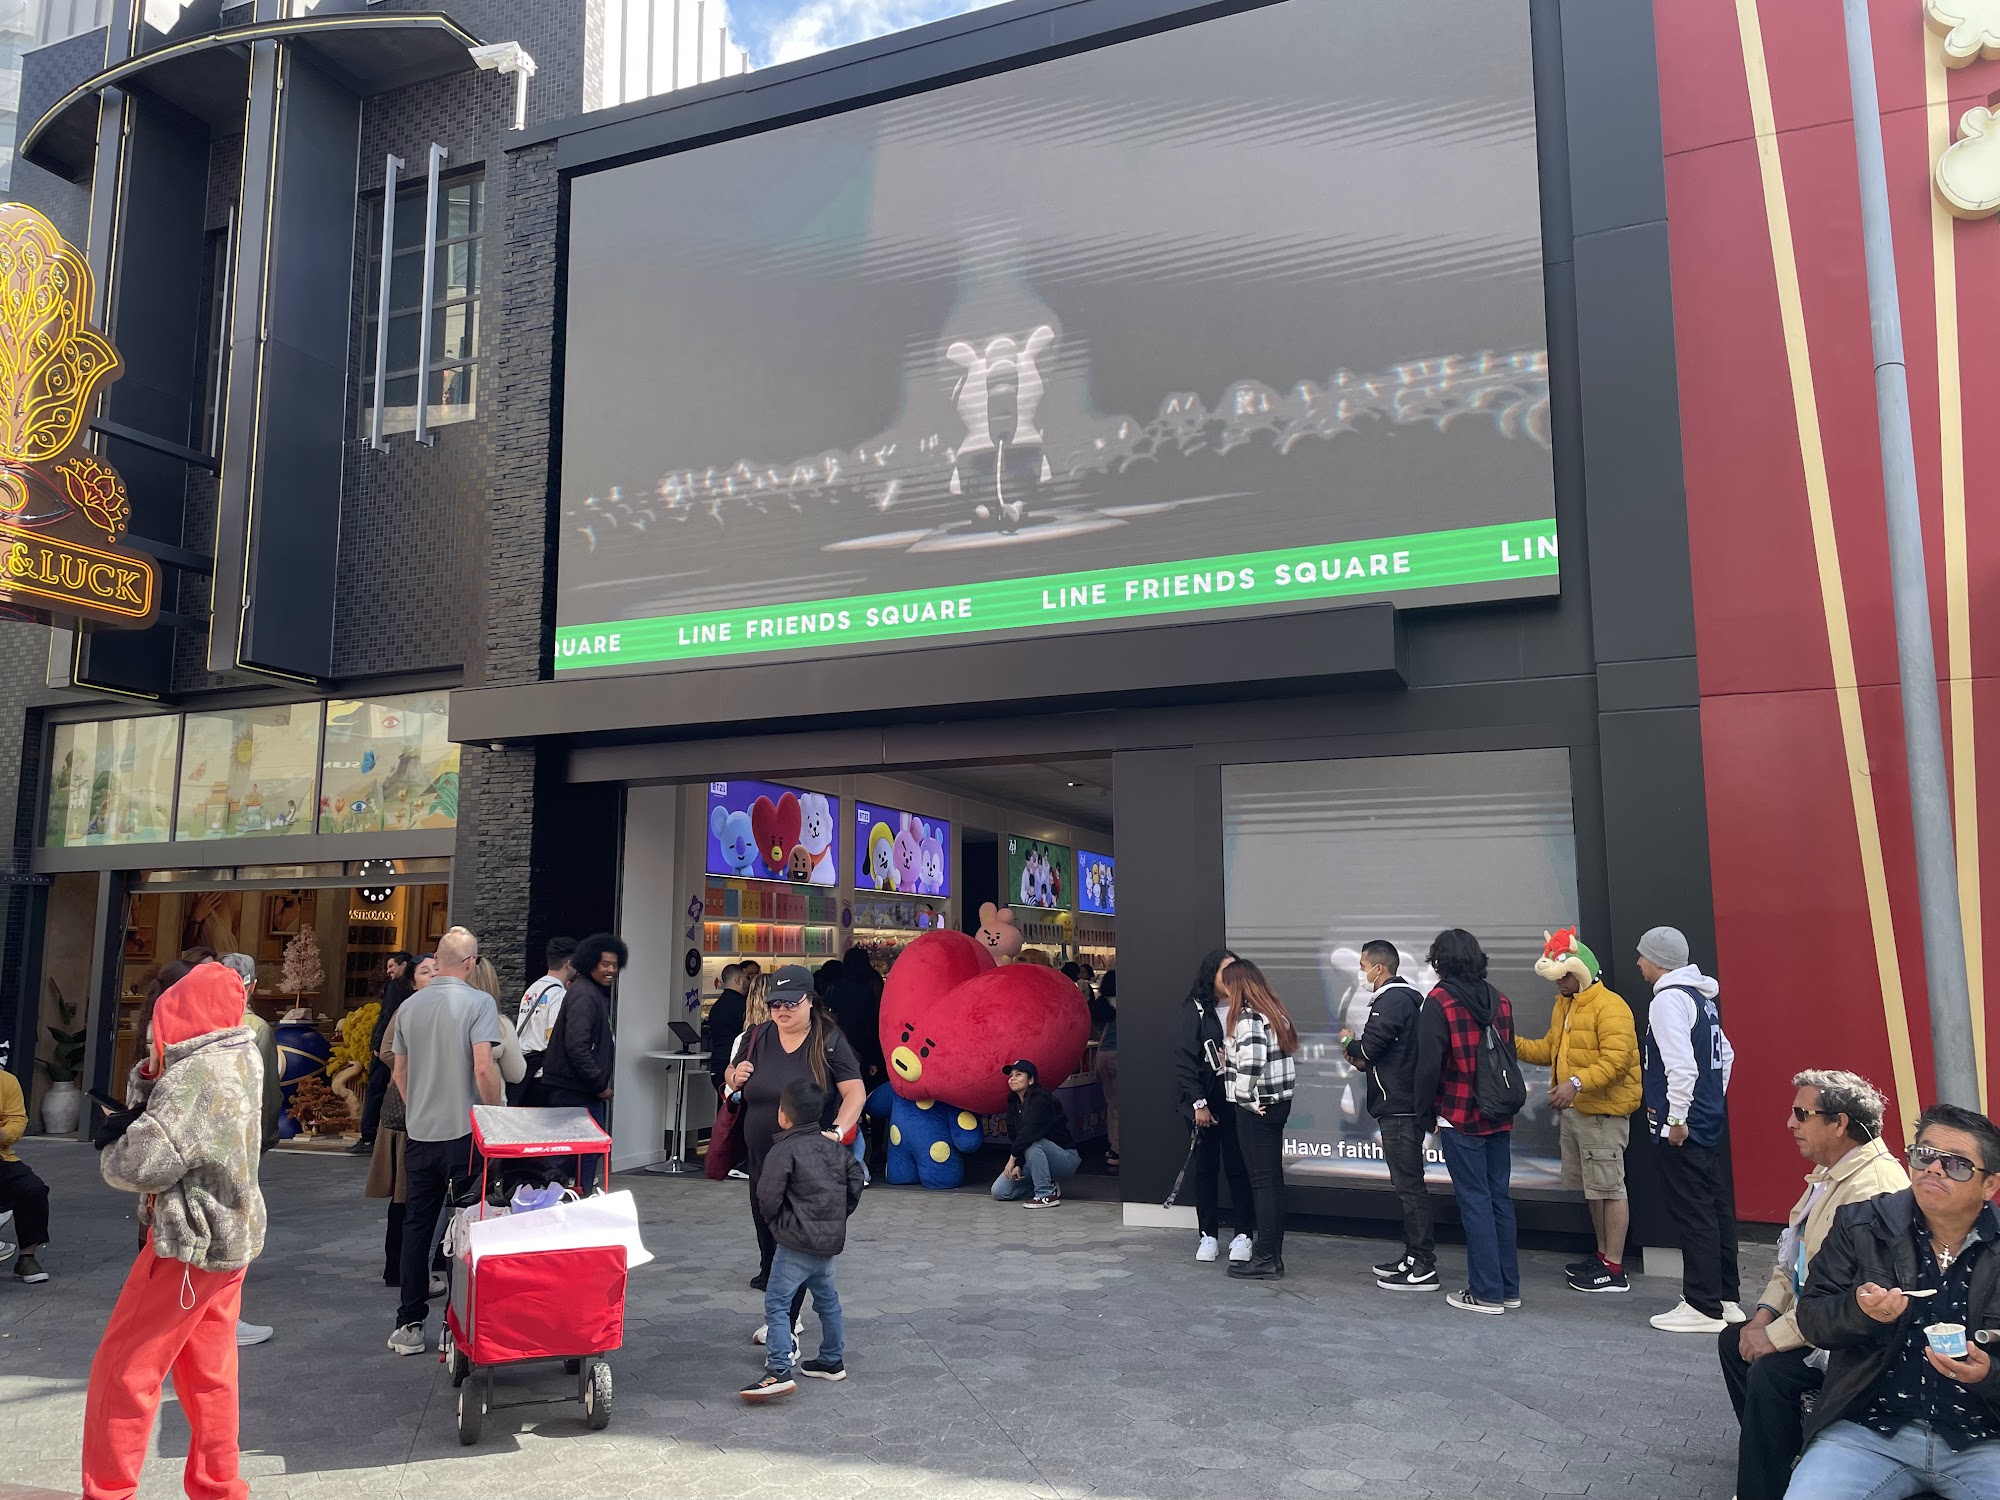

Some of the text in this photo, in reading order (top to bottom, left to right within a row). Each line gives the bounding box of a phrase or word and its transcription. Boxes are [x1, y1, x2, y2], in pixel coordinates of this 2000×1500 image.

[678, 623, 732, 645] LINE
[746, 610, 851, 639] FRIENDS
[866, 598, 972, 627] SQUARE
[1042, 584, 1106, 609] LINE
[1125, 568, 1255, 601] FRIENDS
[1274, 551, 1410, 586] SQUARE
[1284, 1139, 1332, 1156] Have
[1338, 1140, 1384, 1160] faith
[1594, 1276, 1611, 1285] HOKA
